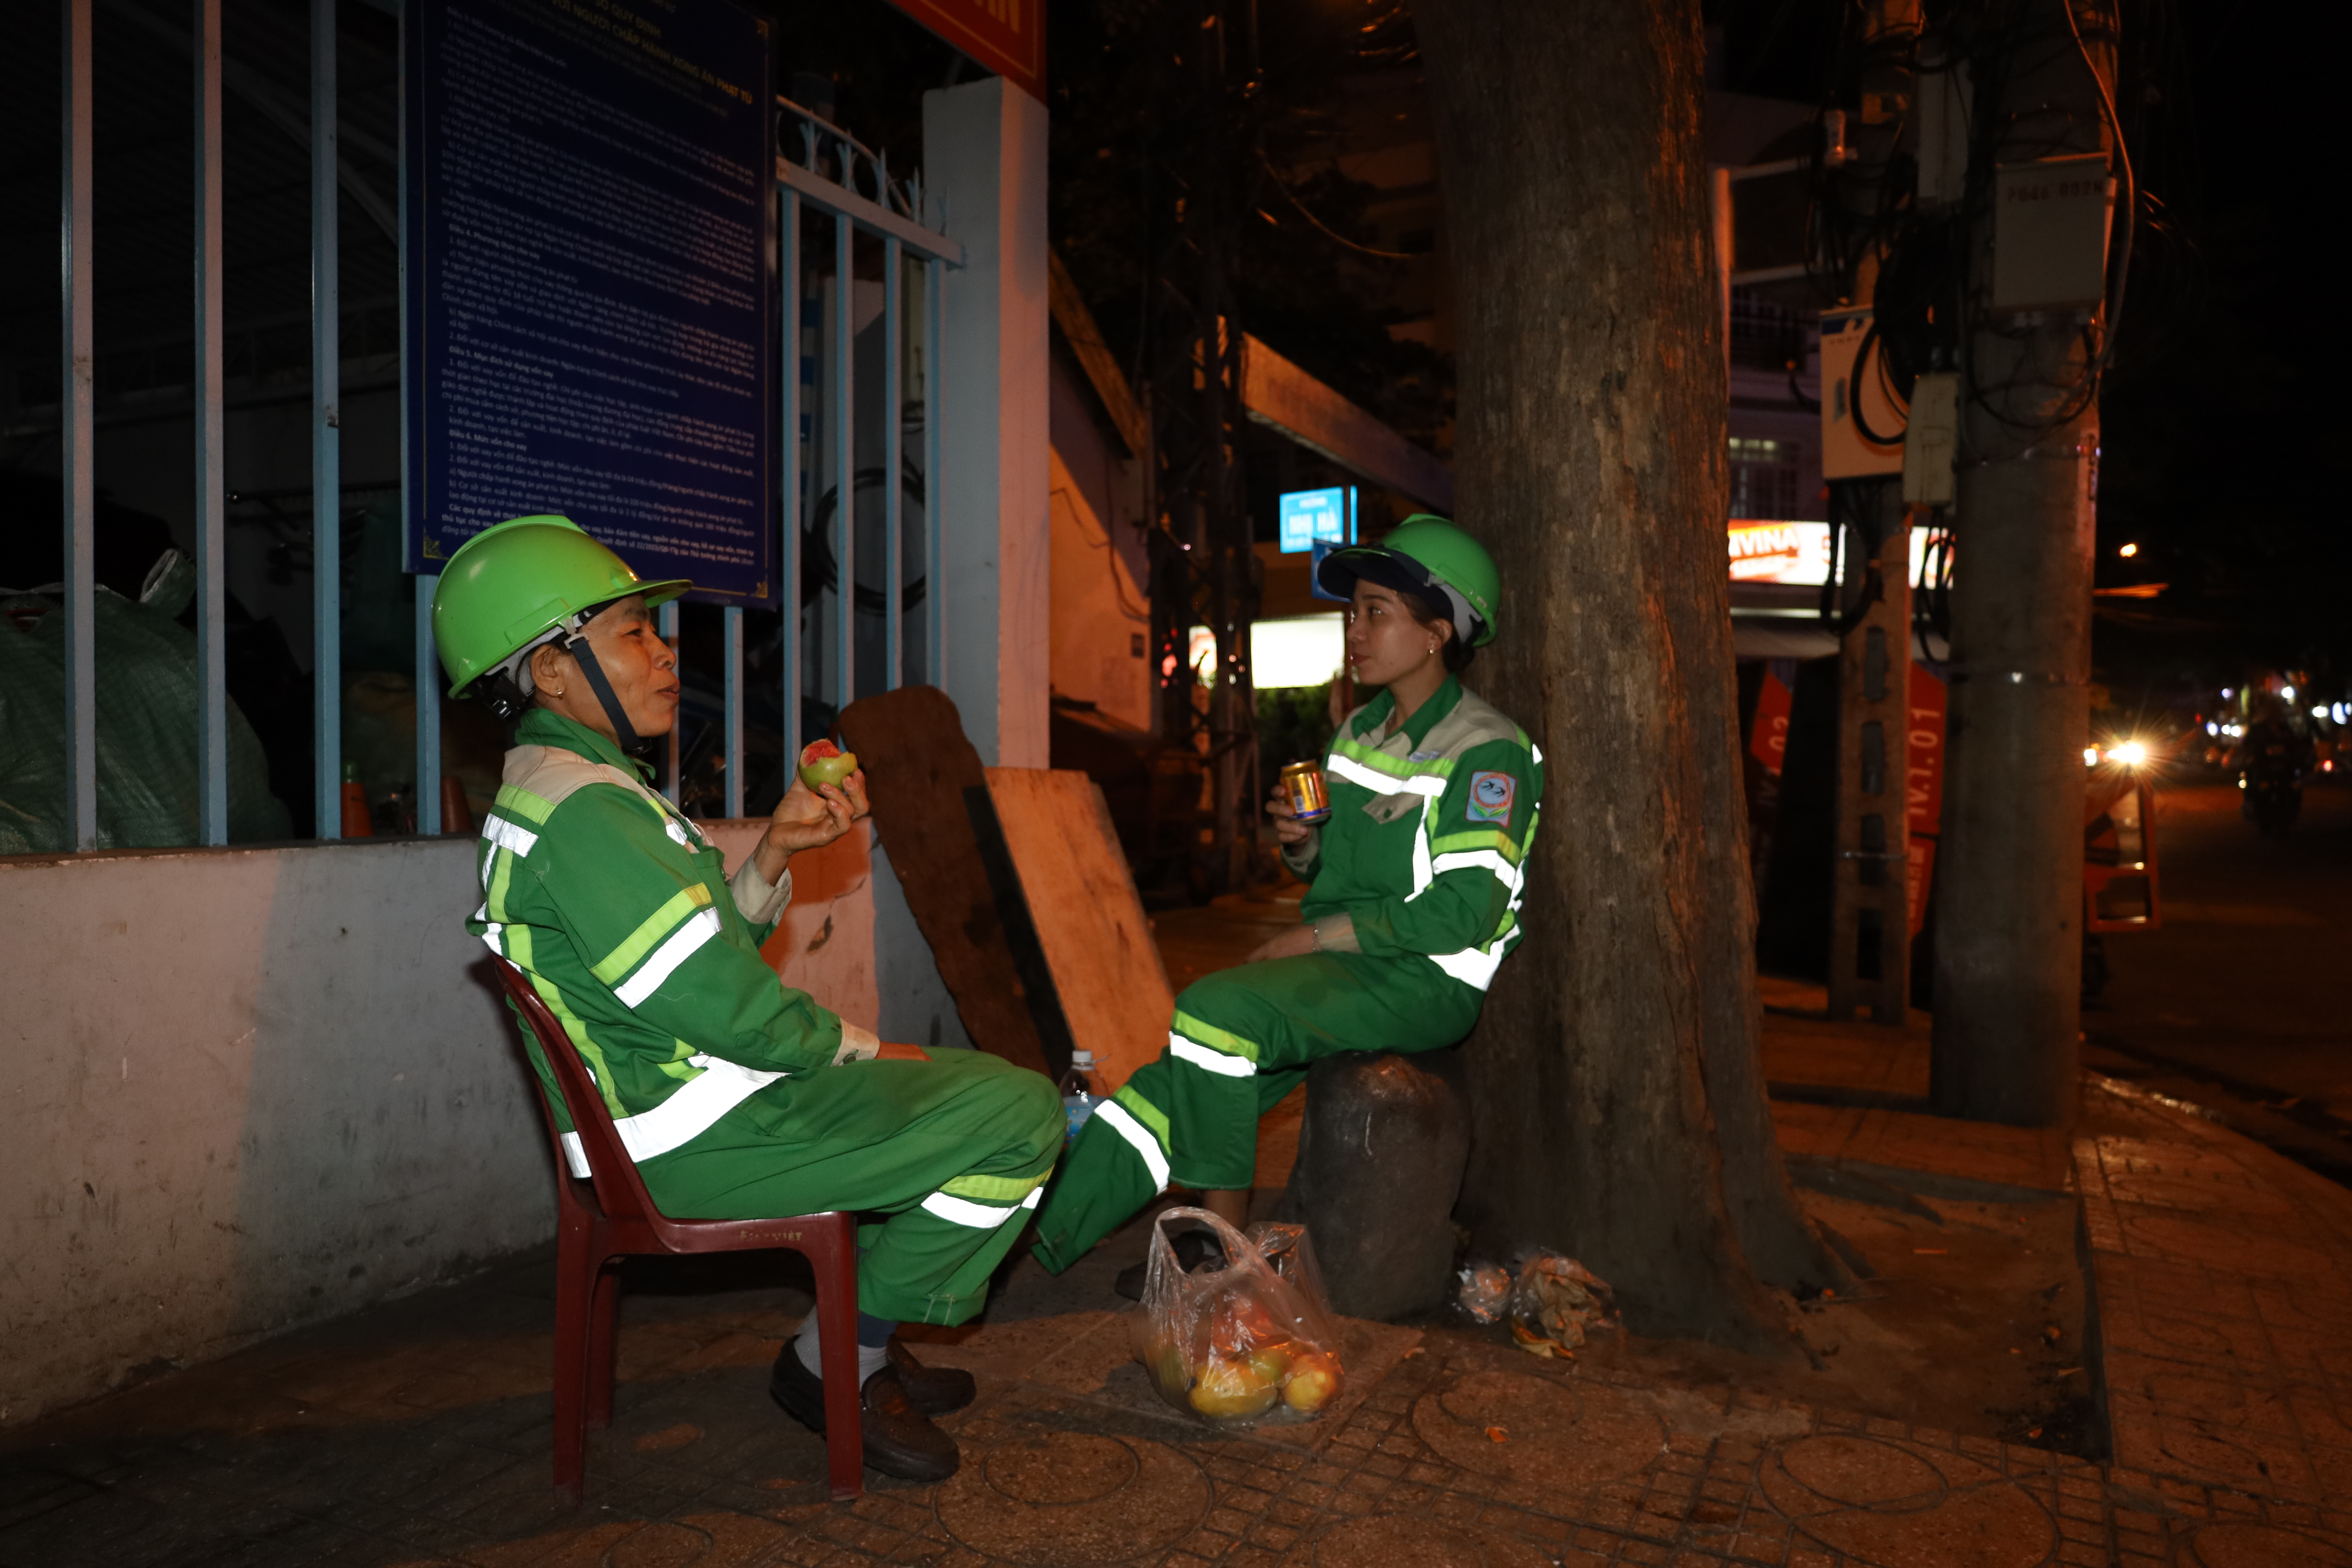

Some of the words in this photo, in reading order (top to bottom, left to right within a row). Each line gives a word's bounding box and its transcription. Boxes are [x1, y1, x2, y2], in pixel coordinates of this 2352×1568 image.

[448, 428, 464, 440] Điều
[473, 433, 488, 445] Mức
[490, 436, 502, 447] vốn
[503, 439, 515, 450] cho
[516, 441, 527, 452] vay
